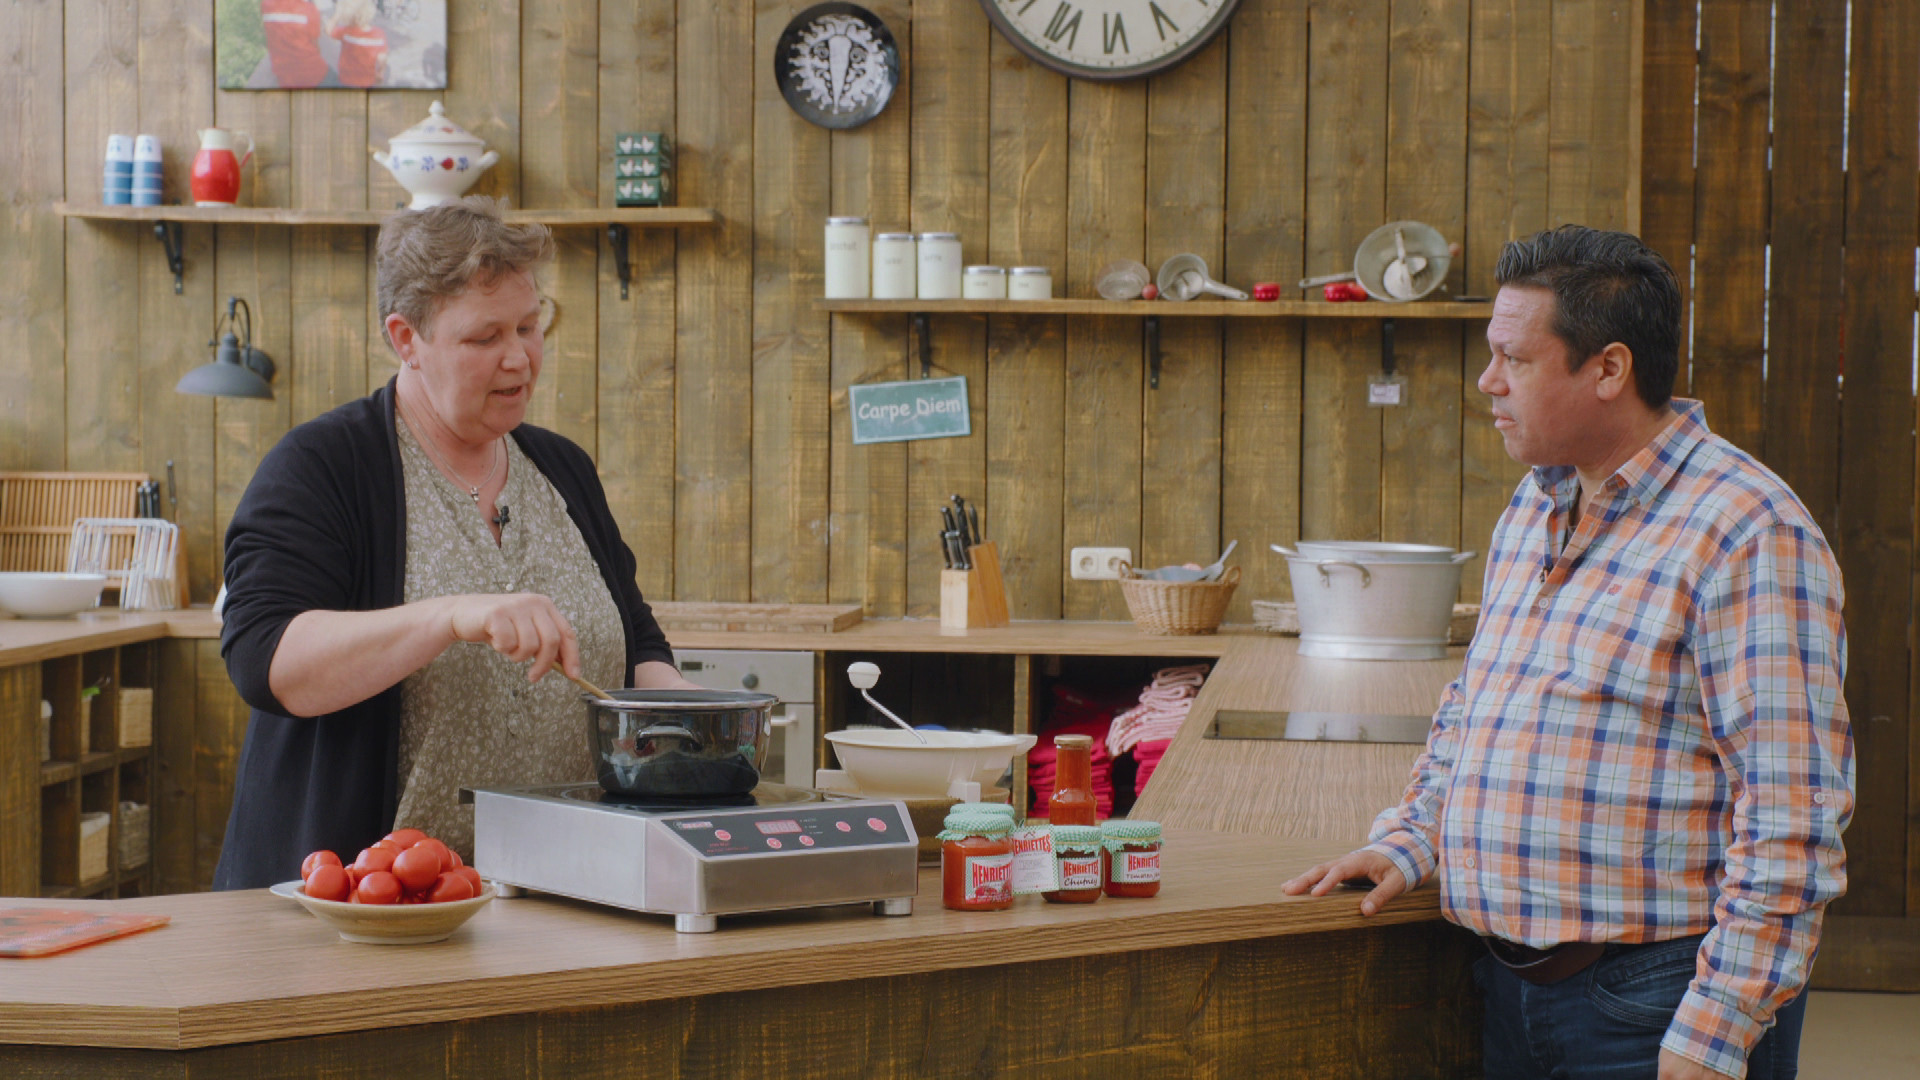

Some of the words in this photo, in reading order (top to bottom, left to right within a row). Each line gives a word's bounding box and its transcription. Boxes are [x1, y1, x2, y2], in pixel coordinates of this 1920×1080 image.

[858, 402, 911, 425] Carpe
[916, 397, 962, 415] Diem
[972, 860, 1012, 888] HENRIETT
[1064, 859, 1098, 878] HENRIETTES
[1064, 877, 1098, 887] Chutney
